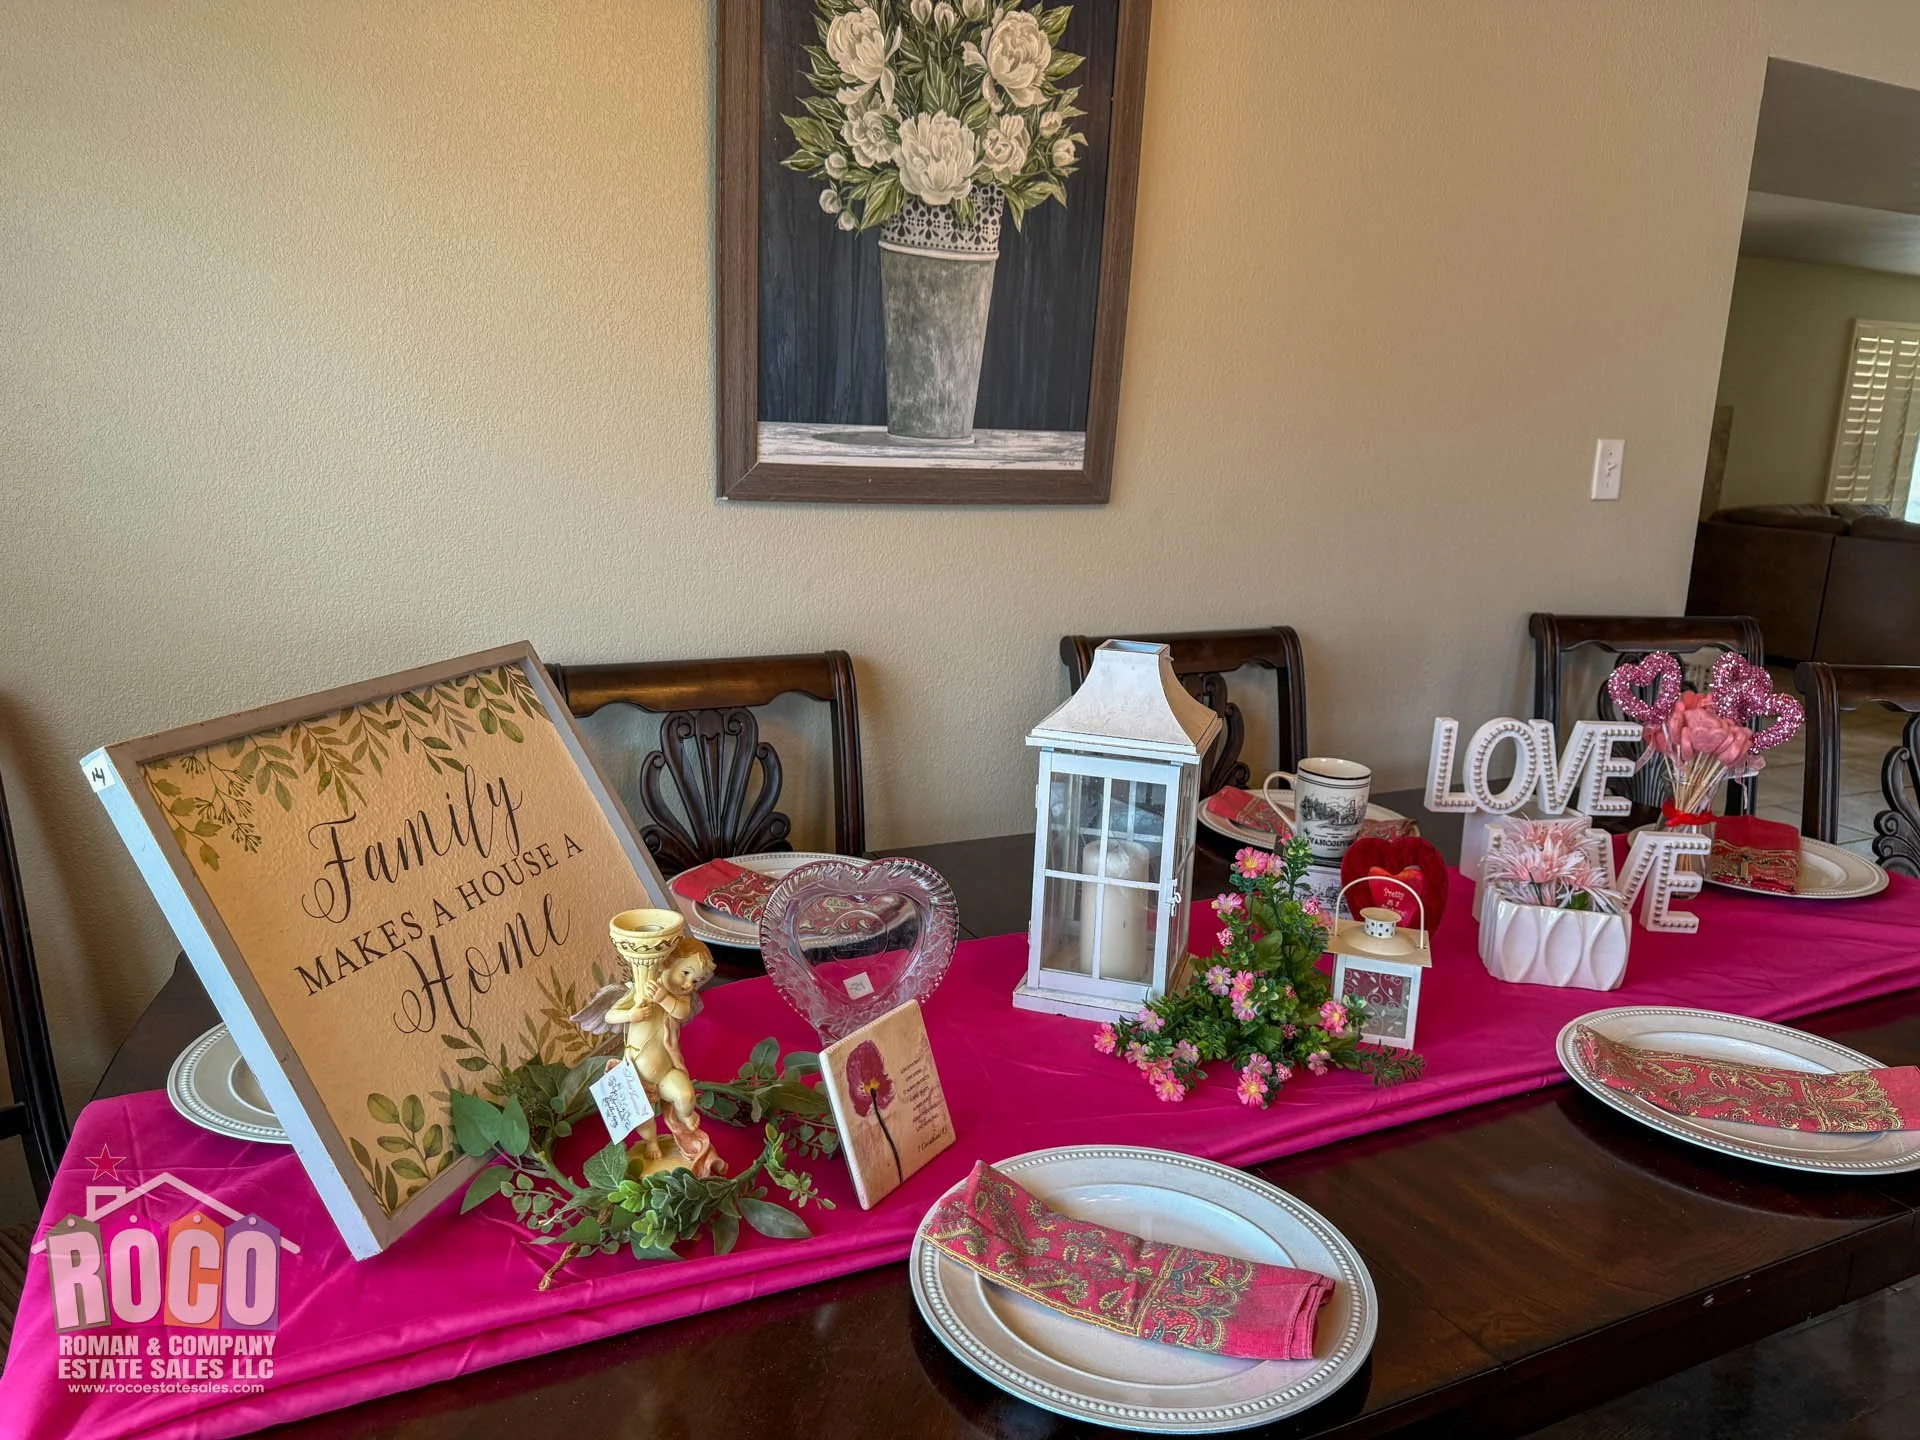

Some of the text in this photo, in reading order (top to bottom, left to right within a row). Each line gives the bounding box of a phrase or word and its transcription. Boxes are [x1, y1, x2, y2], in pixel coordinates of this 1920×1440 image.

[91, 767, 106, 786] 14
[1424, 717, 1643, 817] LOVE
[294, 832, 584, 997] MAKES A HOUSE A
[301, 764, 523, 924] Family
[393, 893, 571, 1034] Home
